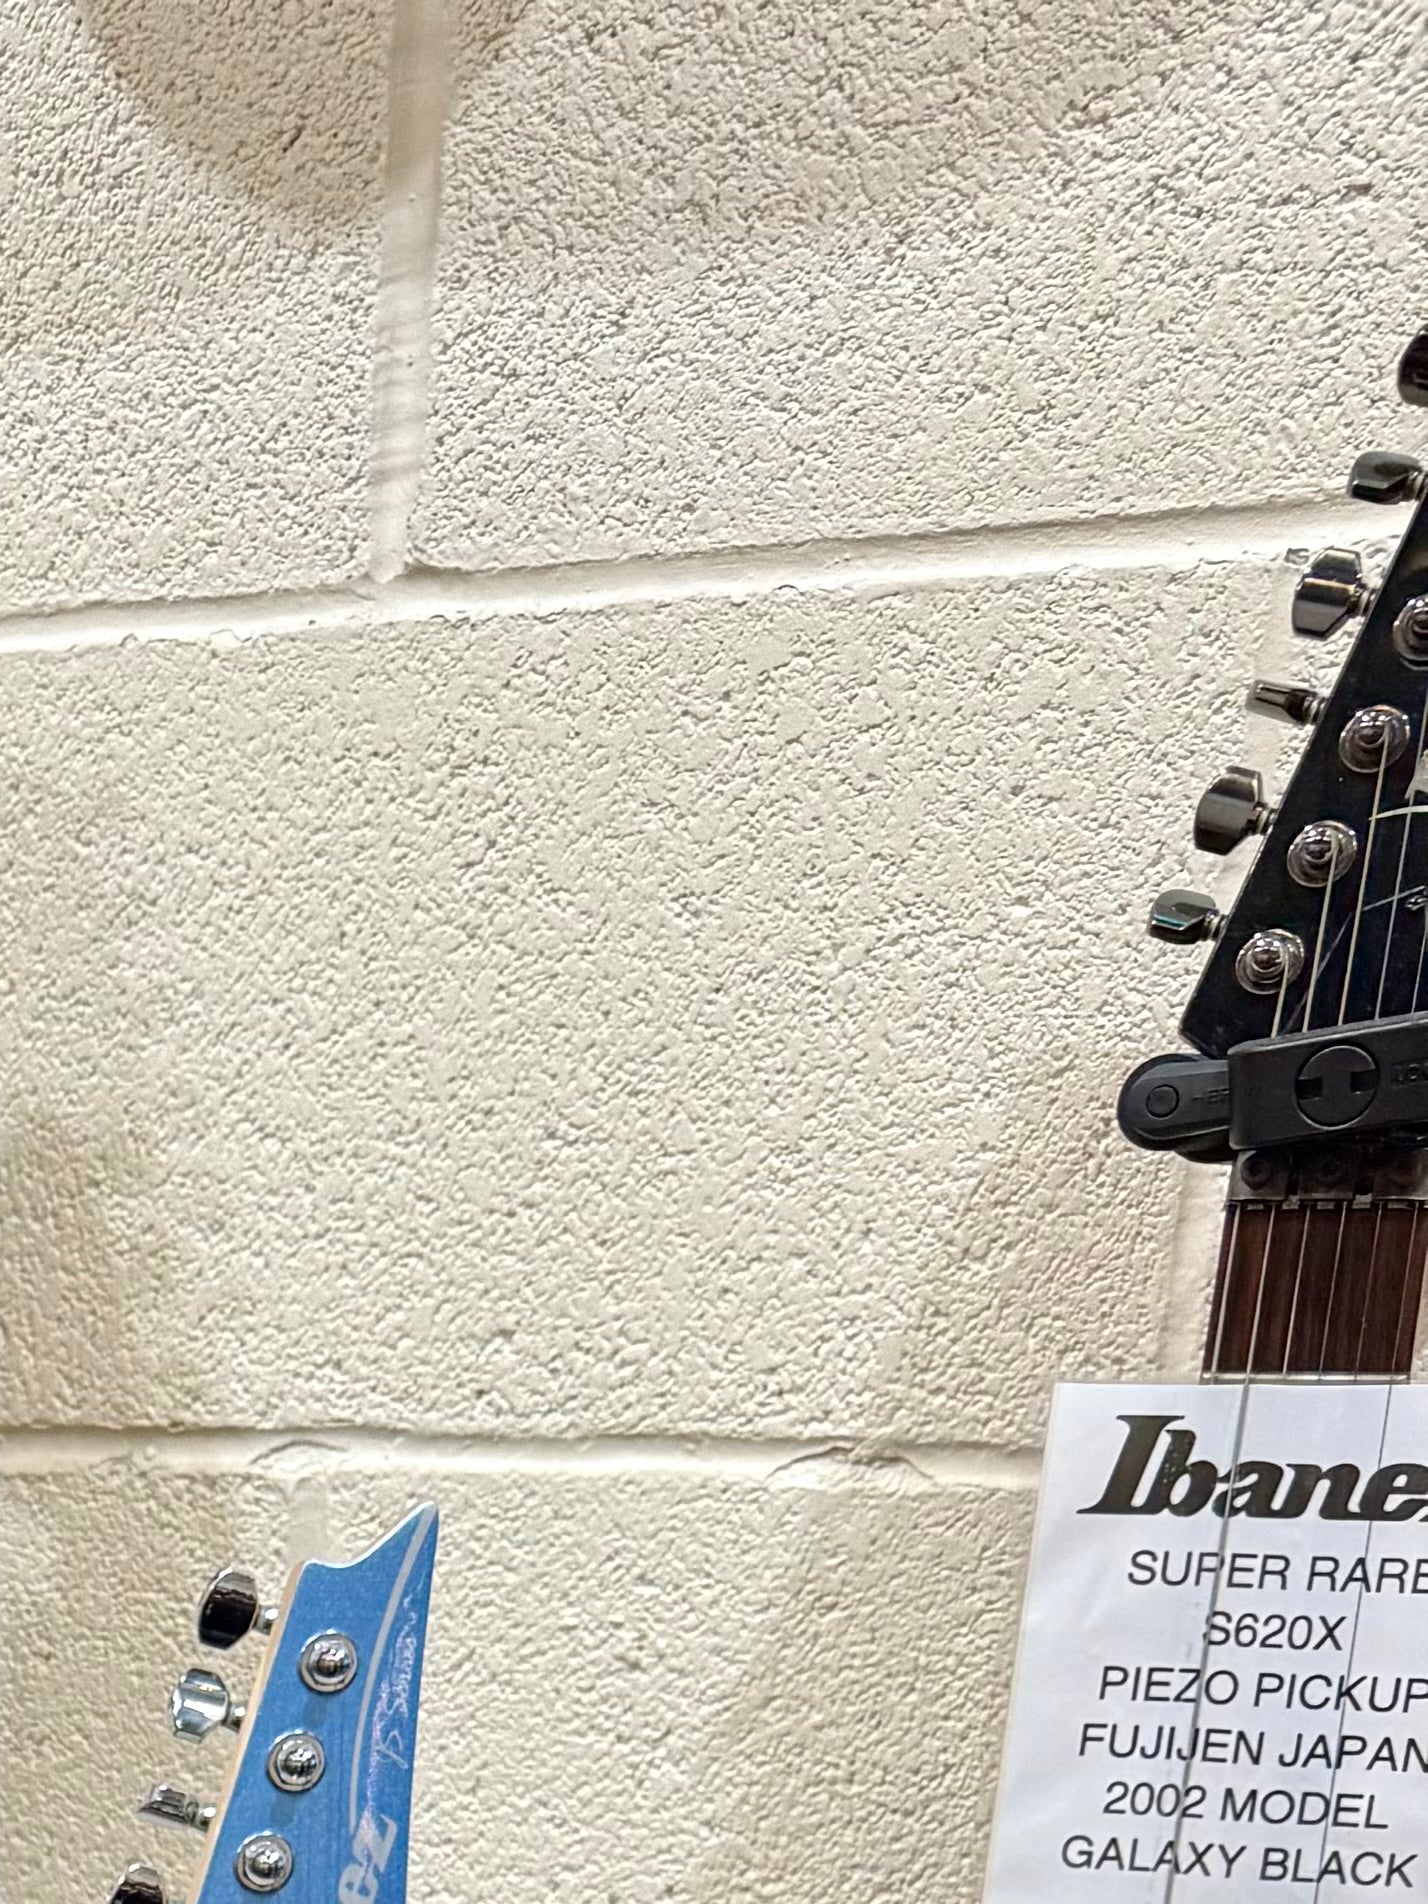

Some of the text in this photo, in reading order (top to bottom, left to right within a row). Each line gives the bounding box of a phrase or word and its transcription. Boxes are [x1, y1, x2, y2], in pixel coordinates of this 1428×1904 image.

[1077, 1414, 1428, 1523] Ibane
[1127, 1550, 1291, 1592] SUPER
[1204, 1612, 1347, 1652] S620X
[1099, 1665, 1238, 1705] PIEZO
[1278, 1731, 1428, 1773] JAPAN
[1103, 1781, 1389, 1830] 2002 MODEL
[1062, 1835, 1417, 1888] GALAXY BLACK
